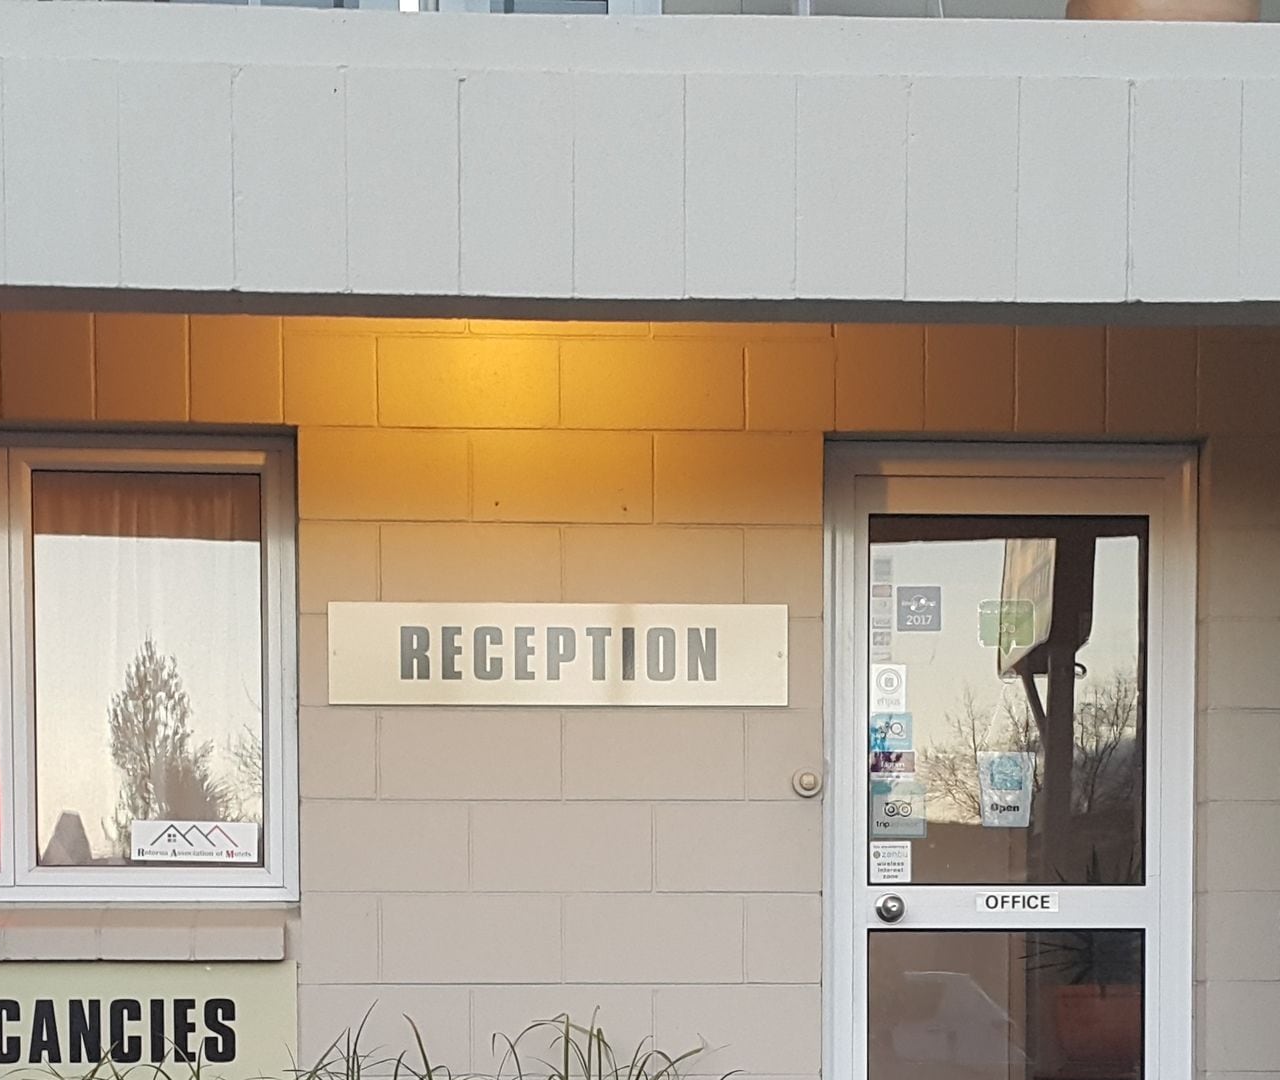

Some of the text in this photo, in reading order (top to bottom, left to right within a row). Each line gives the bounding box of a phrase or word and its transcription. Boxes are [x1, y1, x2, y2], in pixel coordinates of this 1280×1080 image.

[905, 614, 933, 626] 2017
[400, 625, 717, 682] RECEPTION
[990, 802, 1020, 814] Open
[985, 895, 1050, 909] OFFICE
